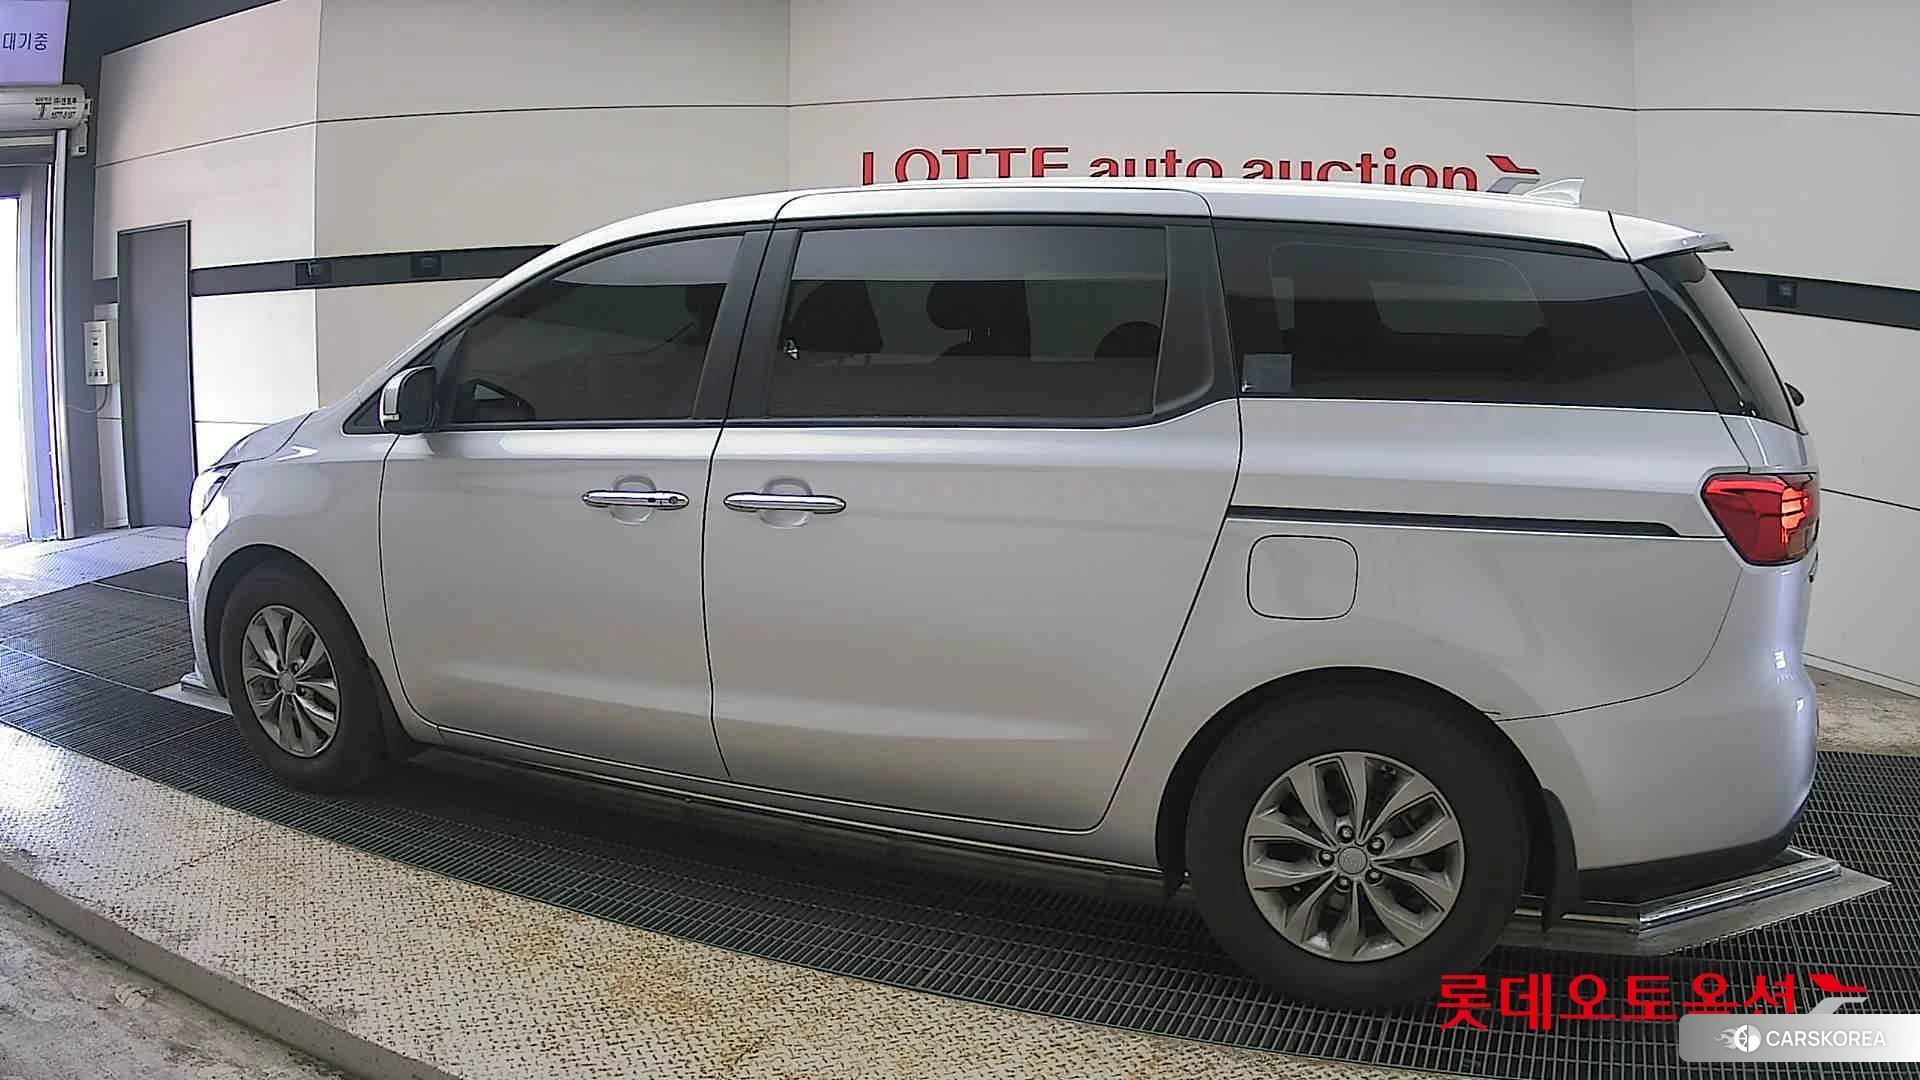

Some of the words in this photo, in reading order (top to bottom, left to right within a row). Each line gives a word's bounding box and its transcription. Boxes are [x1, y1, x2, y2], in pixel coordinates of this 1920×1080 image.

[3, 32, 48, 51] 대기중
[1089, 149, 1224, 178] auto
[1242, 147, 1479, 192] auction
